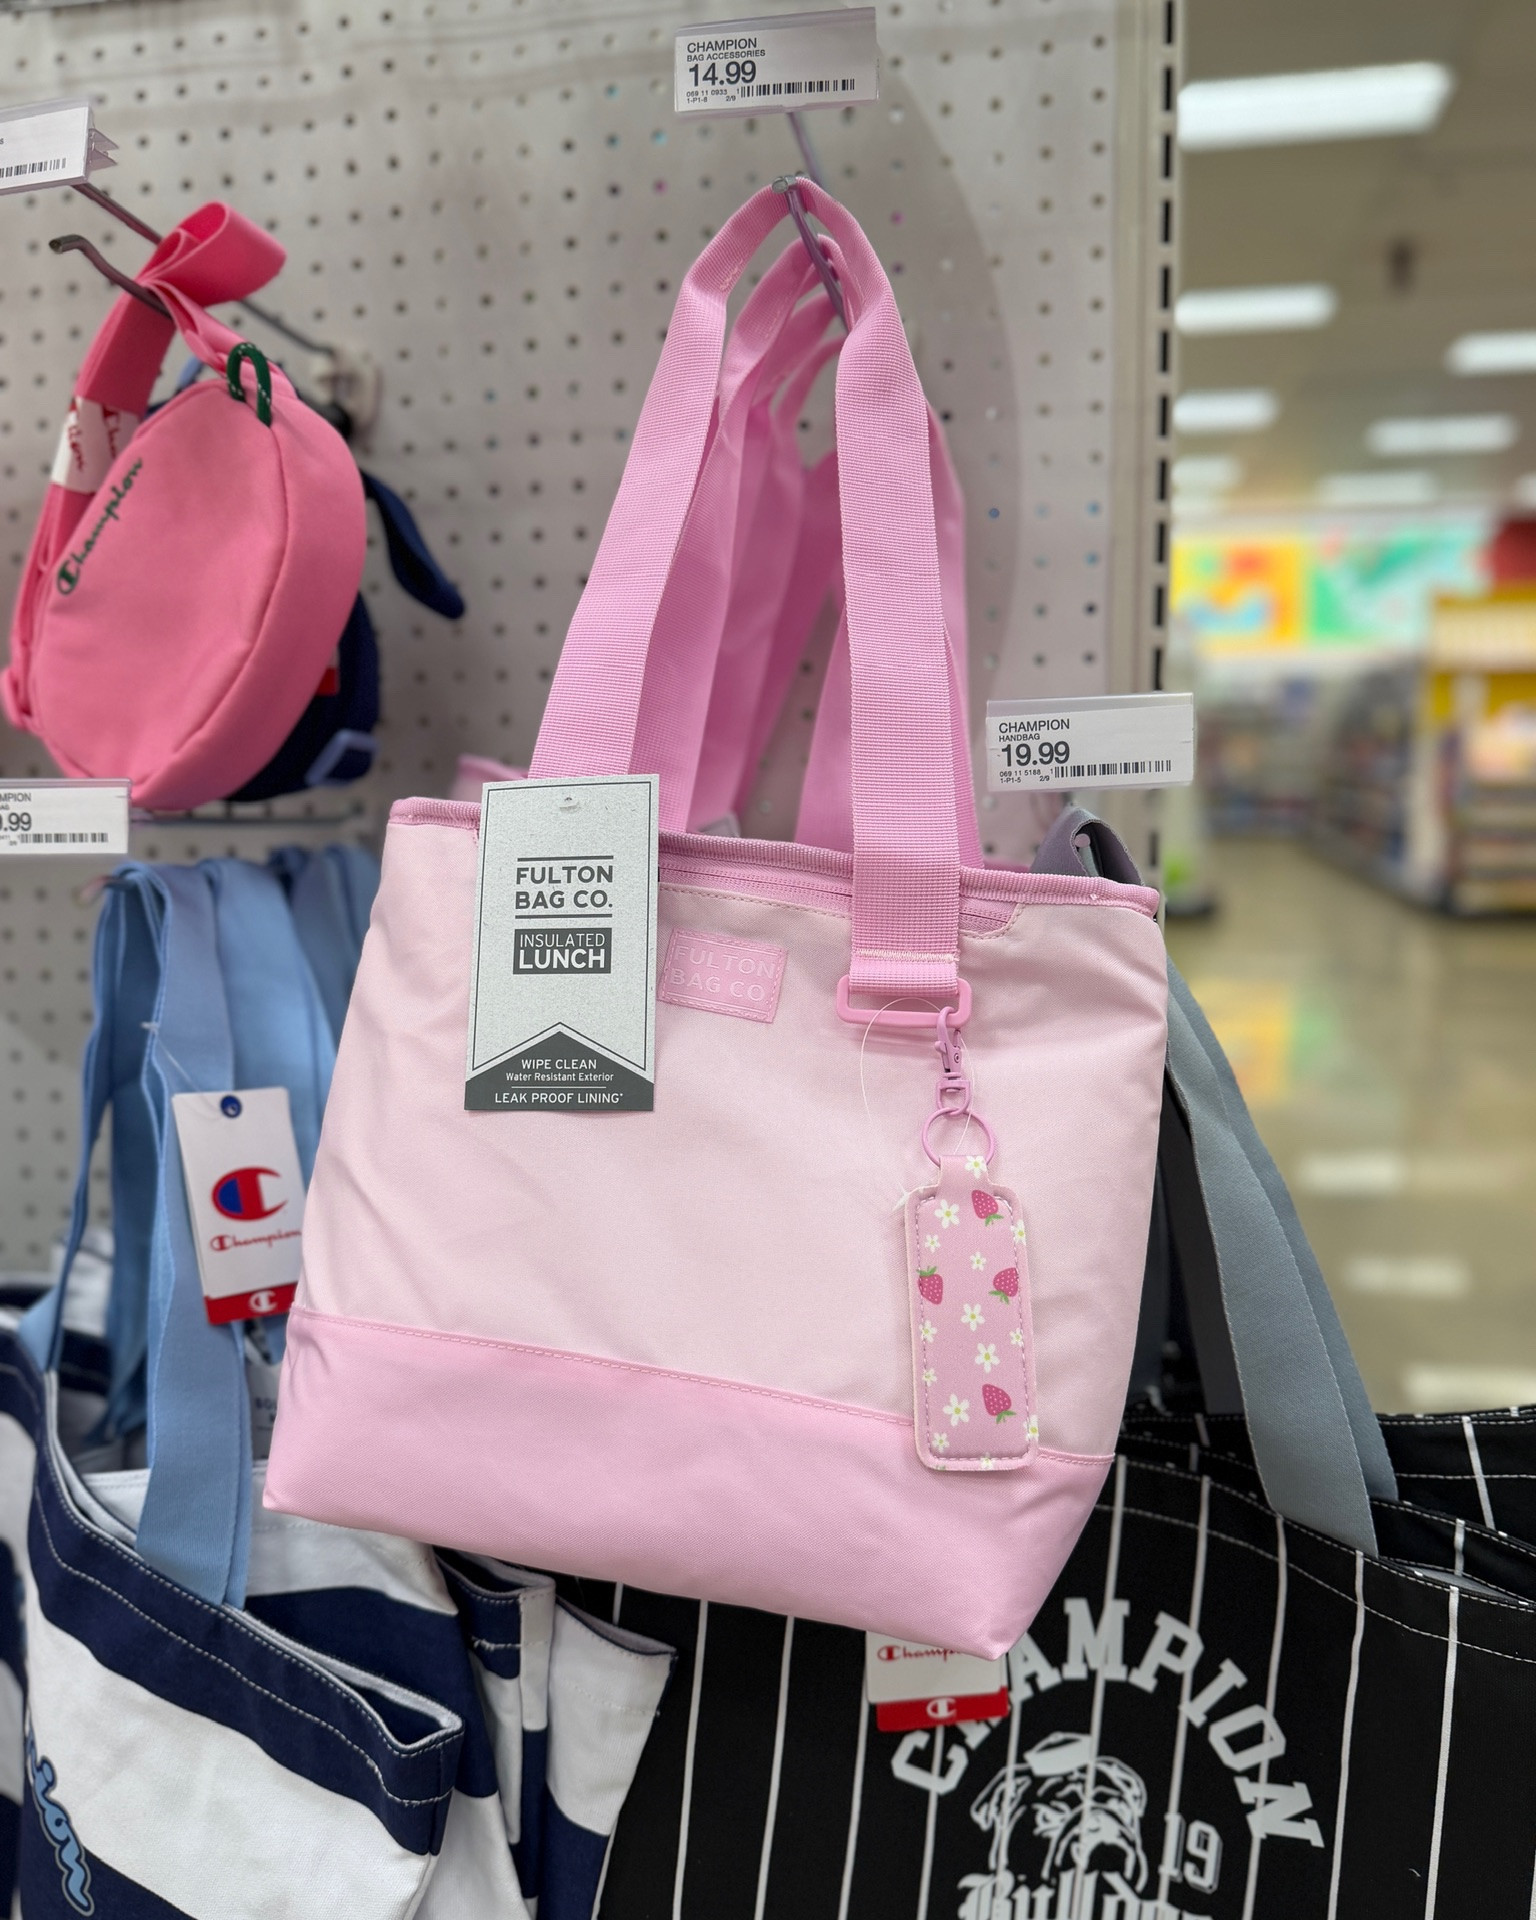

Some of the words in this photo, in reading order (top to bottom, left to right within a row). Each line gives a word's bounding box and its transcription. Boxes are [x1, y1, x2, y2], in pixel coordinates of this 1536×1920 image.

[687, 37, 757, 53] CHAMPION
[687, 54, 704, 62] BAG
[706, 49, 766, 60] ACCESSORIES
[689, 60, 757, 87] 14.99
[57, 458, 142, 596] Champion
[998, 718, 1070, 734] CHAMPION
[998, 733, 1041, 742] HANDBAG
[1001, 741, 1070, 767] 19.99
[516, 865, 613, 885] FULTON
[515, 890, 565, 909] BAG
[573, 889, 613, 908] CO.
[520, 933, 606, 948] INSULATED
[519, 948, 606, 969] LUNCH
[674, 945, 776, 979] FULTON
[669, 968, 721, 993] BAG
[521, 1059, 551, 1070] WIPE
[555, 1059, 597, 1070] CLEAN
[506, 1072, 532, 1082] Water
[534, 1072, 576, 1082] Resistant
[578, 1072, 614, 1082] Exterior
[495, 1092, 528, 1103] LEAK
[531, 1092, 574, 1103] PROOF
[210, 1228, 302, 1252] Champion
[1159, 1812, 1223, 1894] 19
